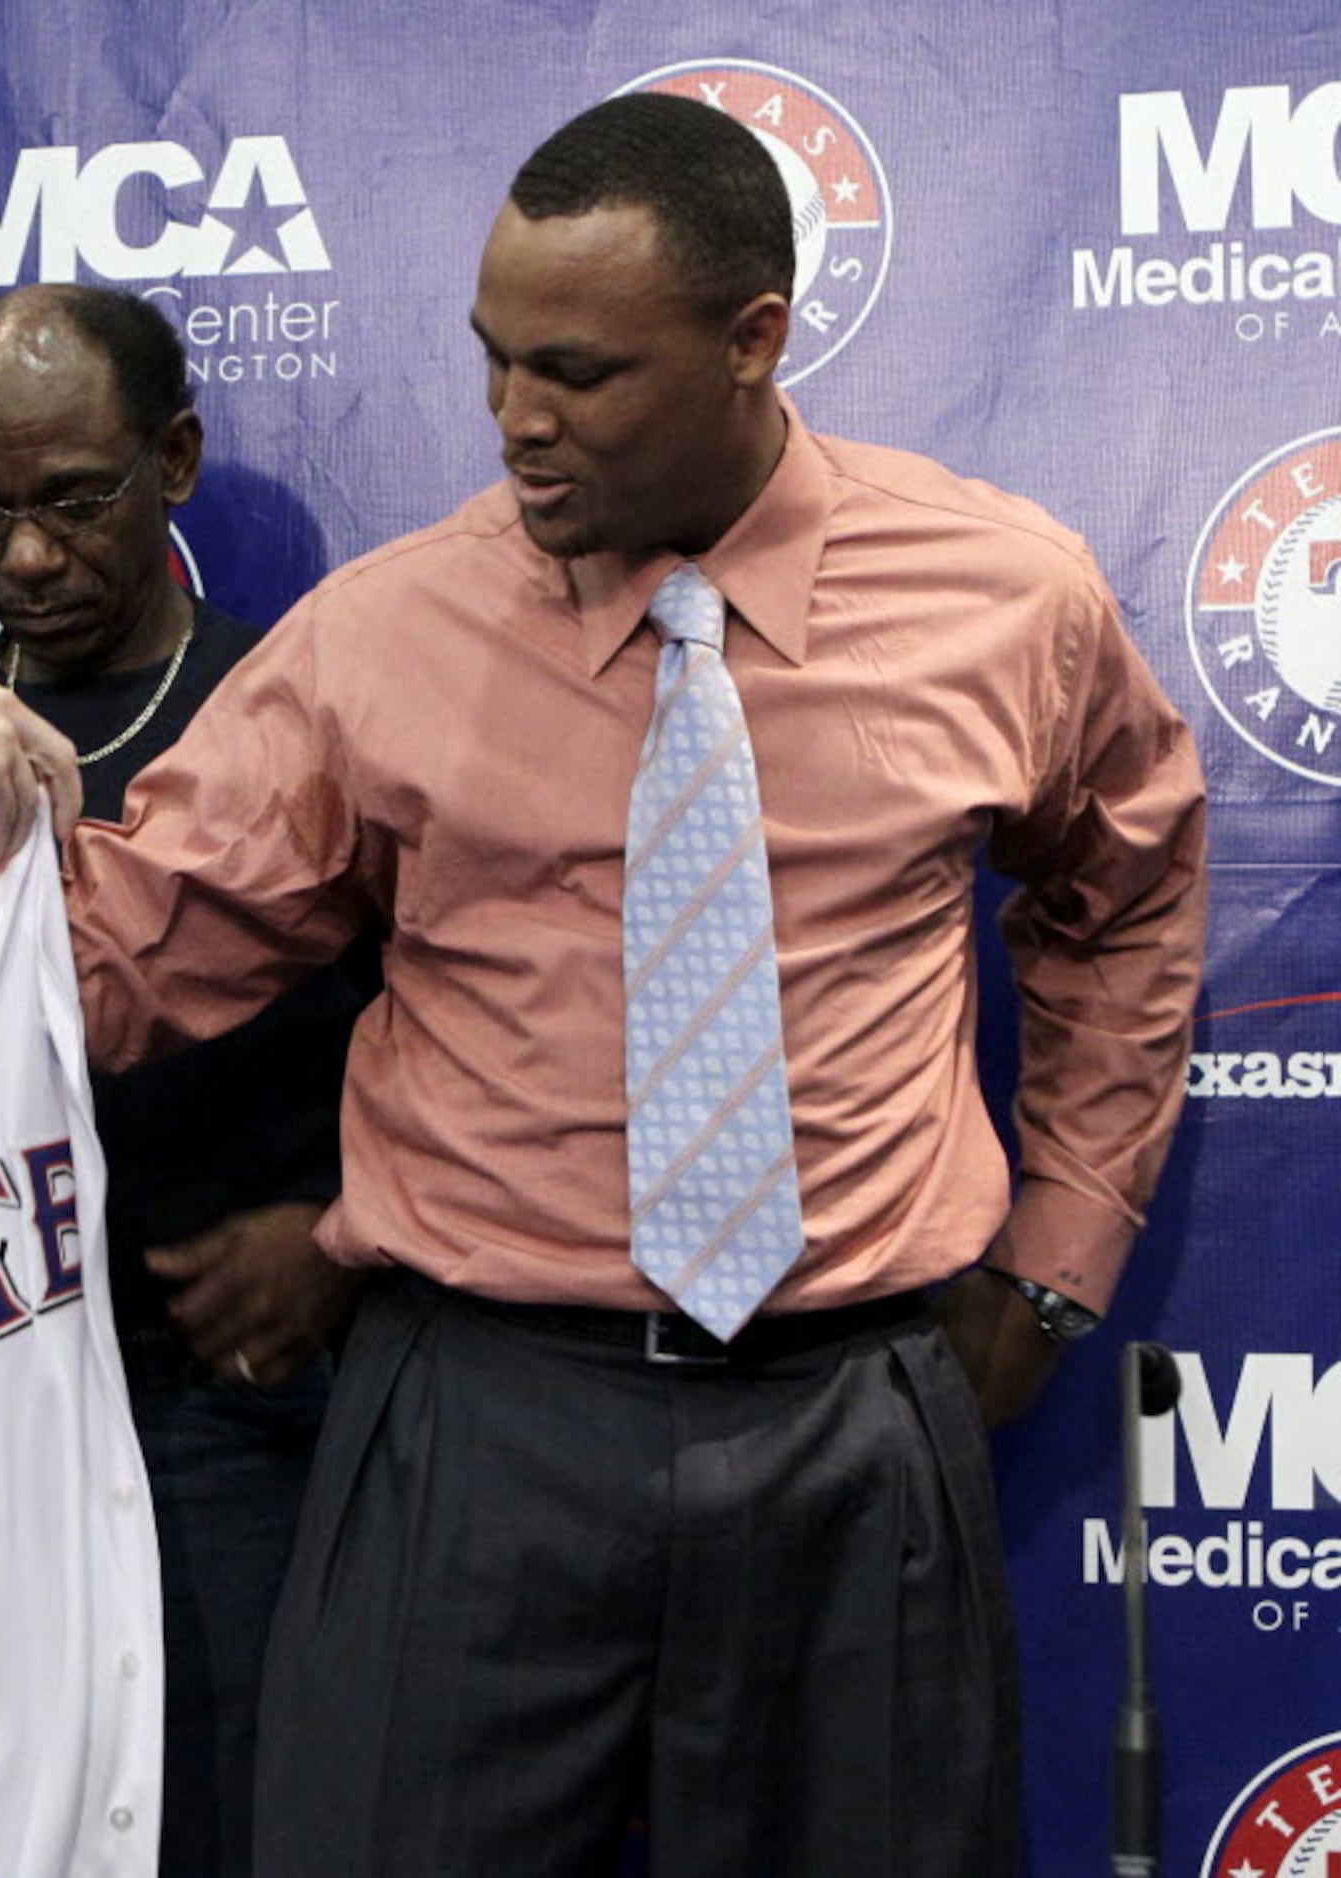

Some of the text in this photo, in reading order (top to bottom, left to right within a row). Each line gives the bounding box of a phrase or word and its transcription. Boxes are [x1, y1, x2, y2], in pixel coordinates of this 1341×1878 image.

[1072, 241, 1341, 309] Medica
[143, 286, 340, 346] enter
[1236, 311, 1290, 341] OF
[1137, 1352, 1341, 1511] M
[1253, 1600, 1309, 1631] OF
